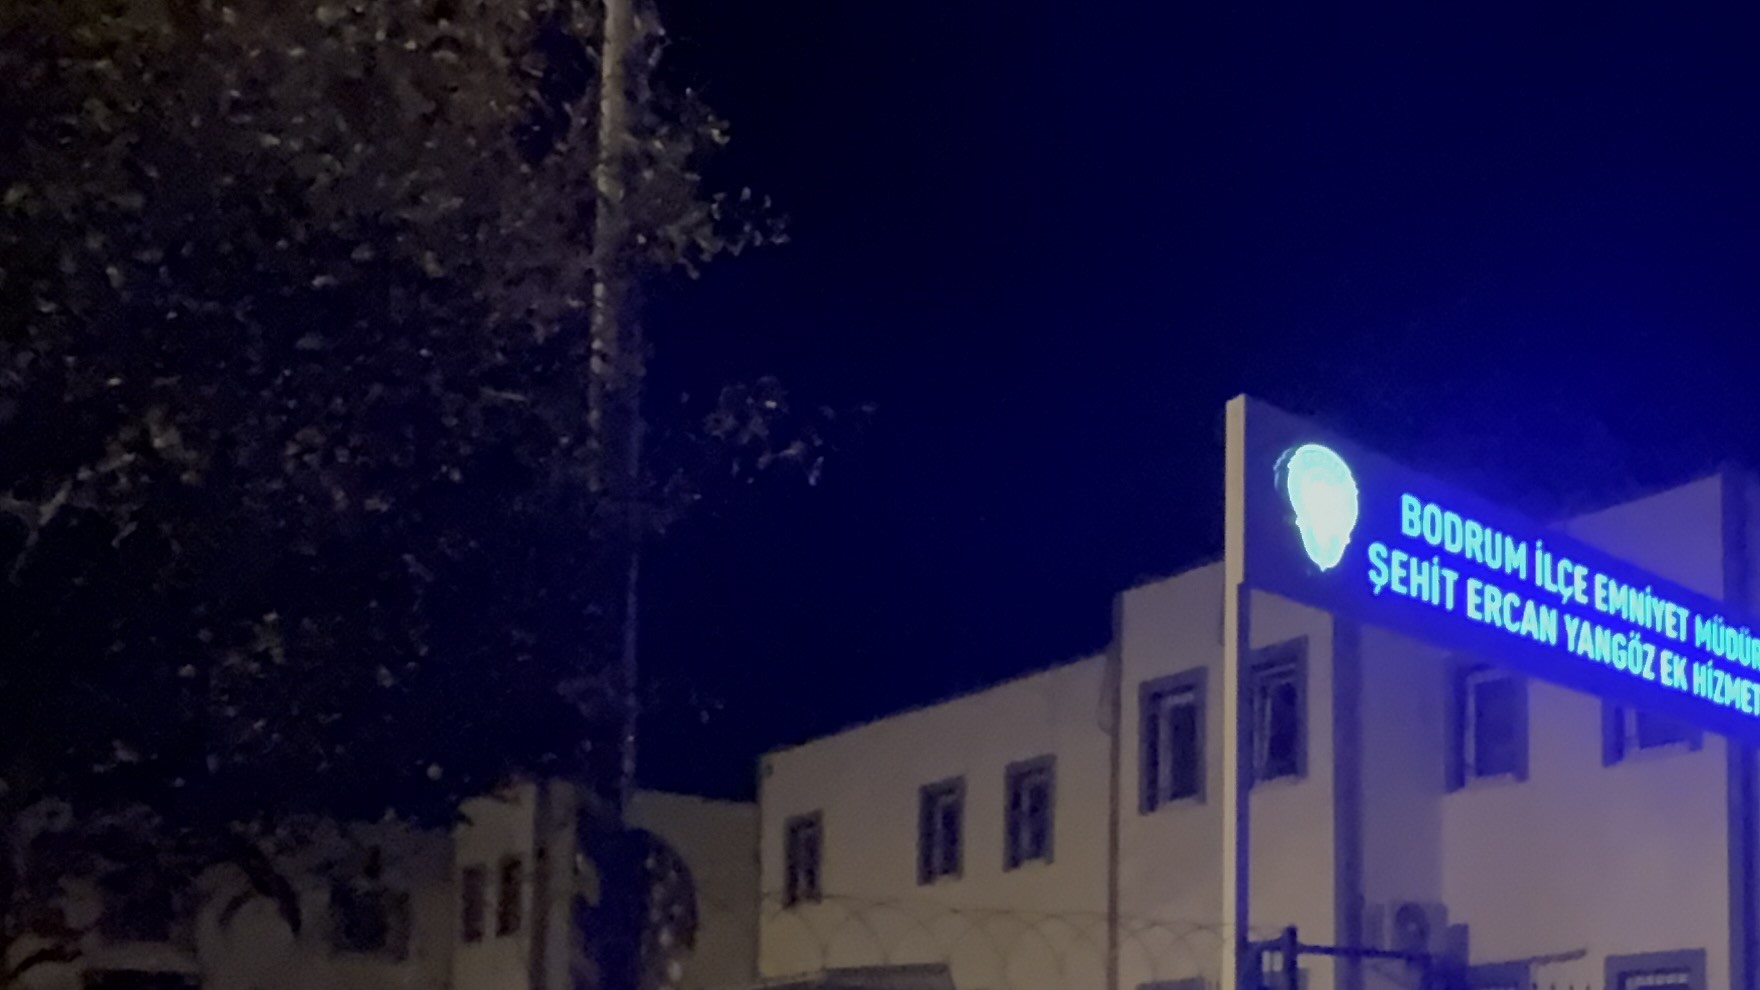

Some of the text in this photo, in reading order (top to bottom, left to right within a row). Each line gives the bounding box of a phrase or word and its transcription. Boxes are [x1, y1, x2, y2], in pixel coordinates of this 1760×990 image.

[1368, 542, 1459, 610] ŞEHİT
[1467, 578, 1558, 646] ERCAN
[1564, 614, 1657, 680] YANGÖZ
[1660, 649, 1688, 691] EK
[1401, 493, 1528, 580] BODRUM
[1535, 540, 1589, 604] İLÇE
[1594, 573, 1690, 642] EMNİYET
